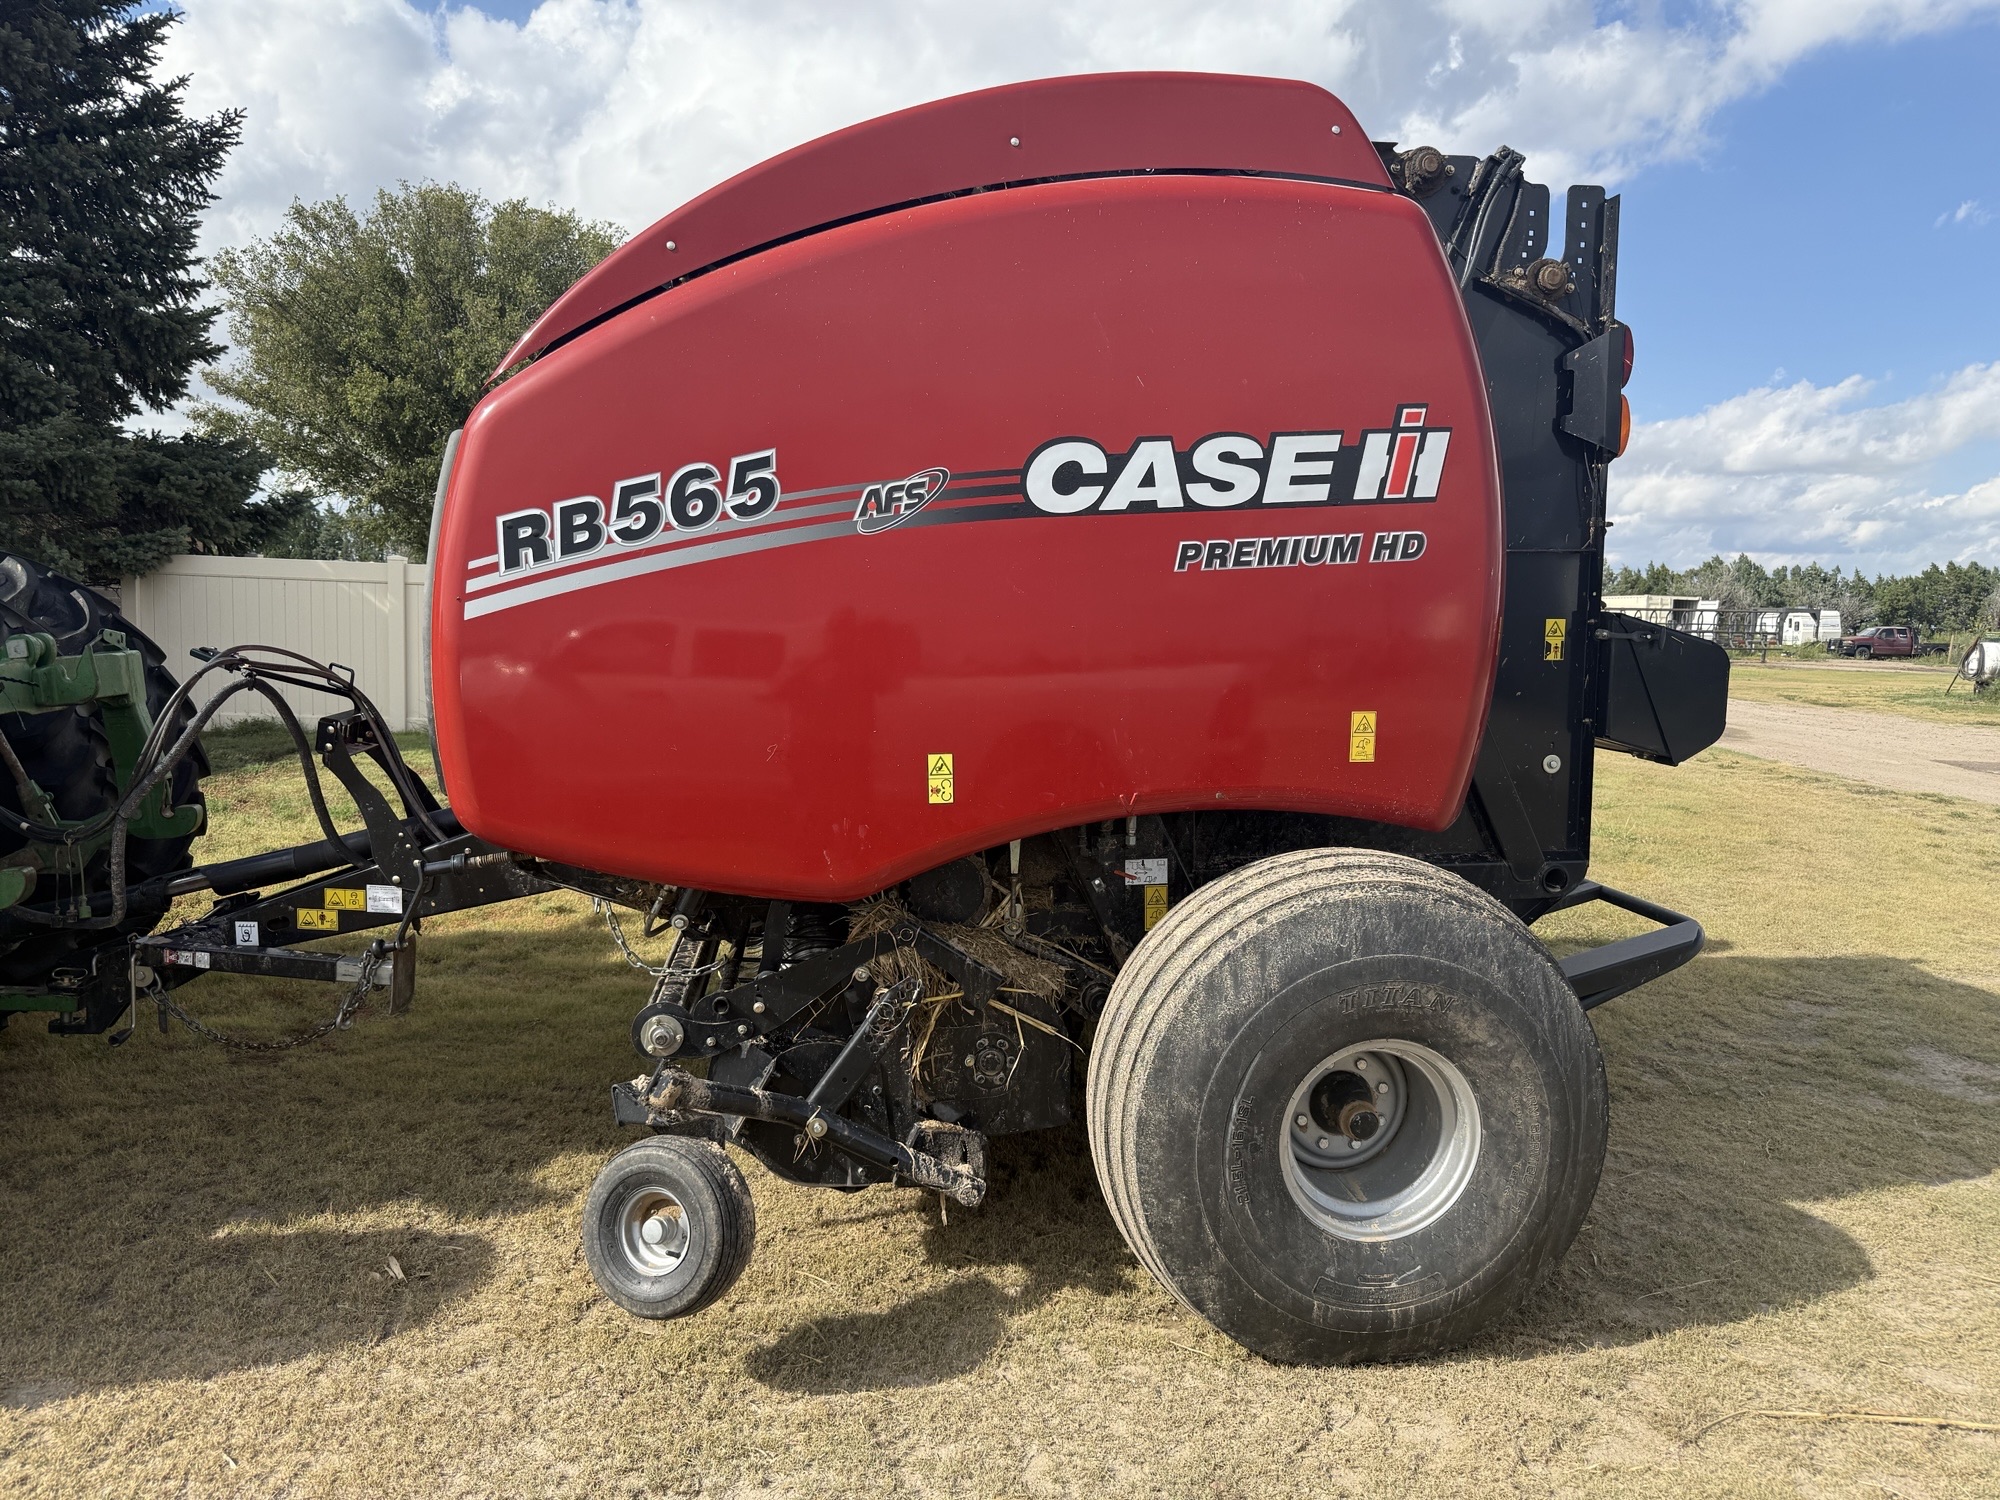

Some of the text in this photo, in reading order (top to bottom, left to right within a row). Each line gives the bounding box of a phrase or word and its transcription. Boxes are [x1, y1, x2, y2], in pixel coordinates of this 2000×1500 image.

[1025, 405, 1452, 514] CASE IH
[496, 448, 781, 577] RB565
[853, 477, 930, 522] AFS
[1174, 531, 1427, 572] PREMIUM HD
[1337, 984, 1459, 1015] TITAN
[1230, 1096, 1256, 1205] 21.5L-16.1SL
